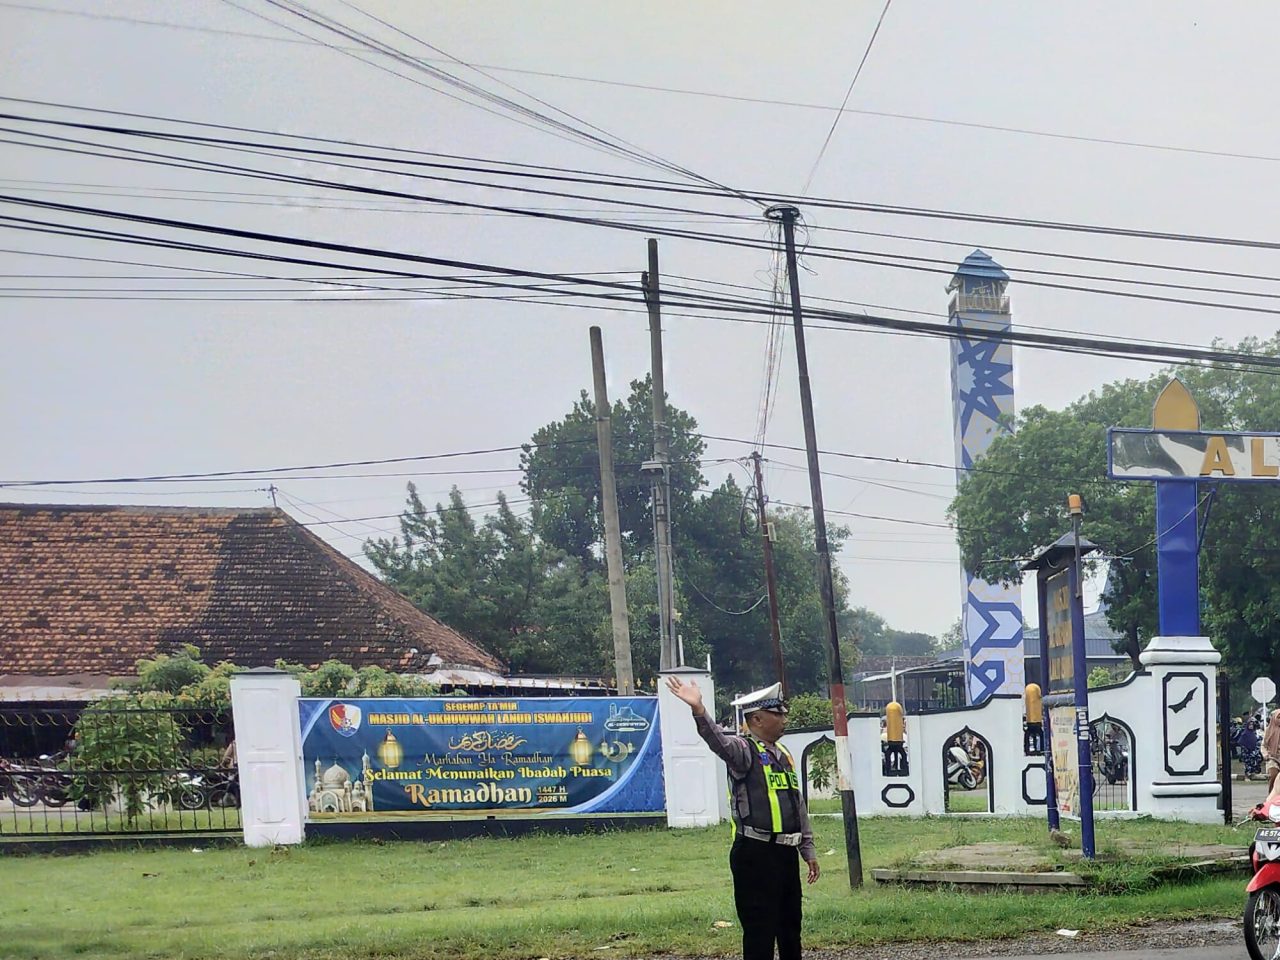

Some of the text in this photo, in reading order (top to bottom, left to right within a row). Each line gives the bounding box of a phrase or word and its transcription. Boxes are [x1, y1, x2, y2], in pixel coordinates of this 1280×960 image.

[1200, 436, 1280, 478] AL
[445, 702, 517, 711] SEGENAP TA'MIR
[369, 712, 593, 725] MASJID AL-UKHUWWAH LANUD ISWAHJUDI
[417, 752, 553, 767] Marhaban Ya Ramadhan
[365, 766, 612, 782] Selamat Menunaikan Ibadah Puasa
[404, 782, 532, 807] Ramadhan
[538, 795, 558, 803] 2026
